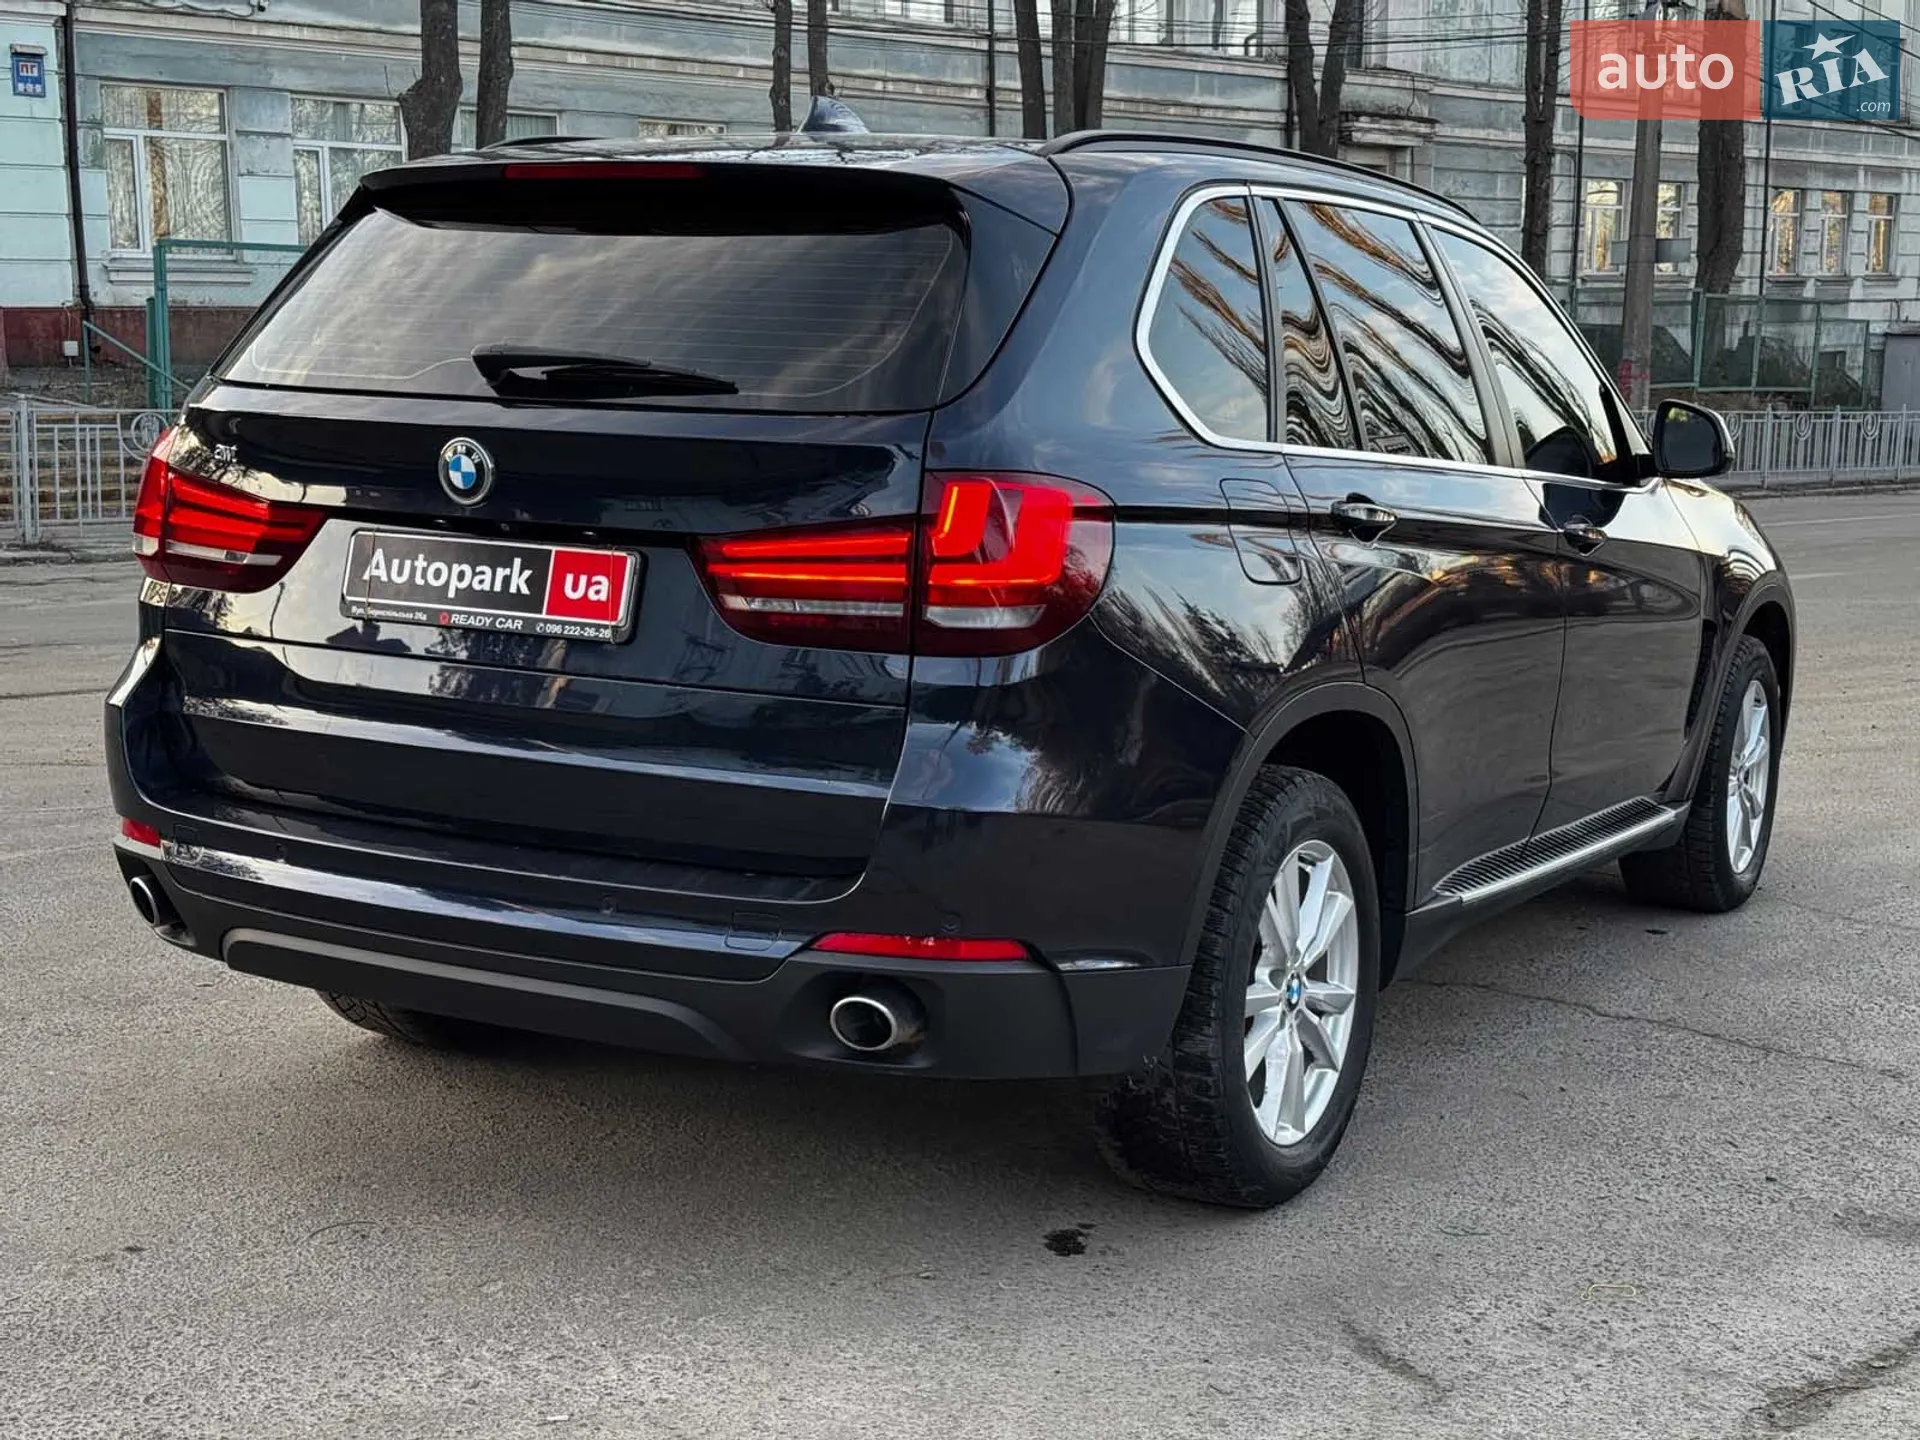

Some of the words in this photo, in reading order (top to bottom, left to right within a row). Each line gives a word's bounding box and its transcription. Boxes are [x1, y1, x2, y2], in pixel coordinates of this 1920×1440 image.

[363, 547, 533, 599] Autopark
[563, 572, 610, 602] ua
[451, 613, 494, 627] READY
[496, 617, 524, 631] CAR
[546, 626, 562, 635] 096
[564, 626, 611, 639] 222-26-26
